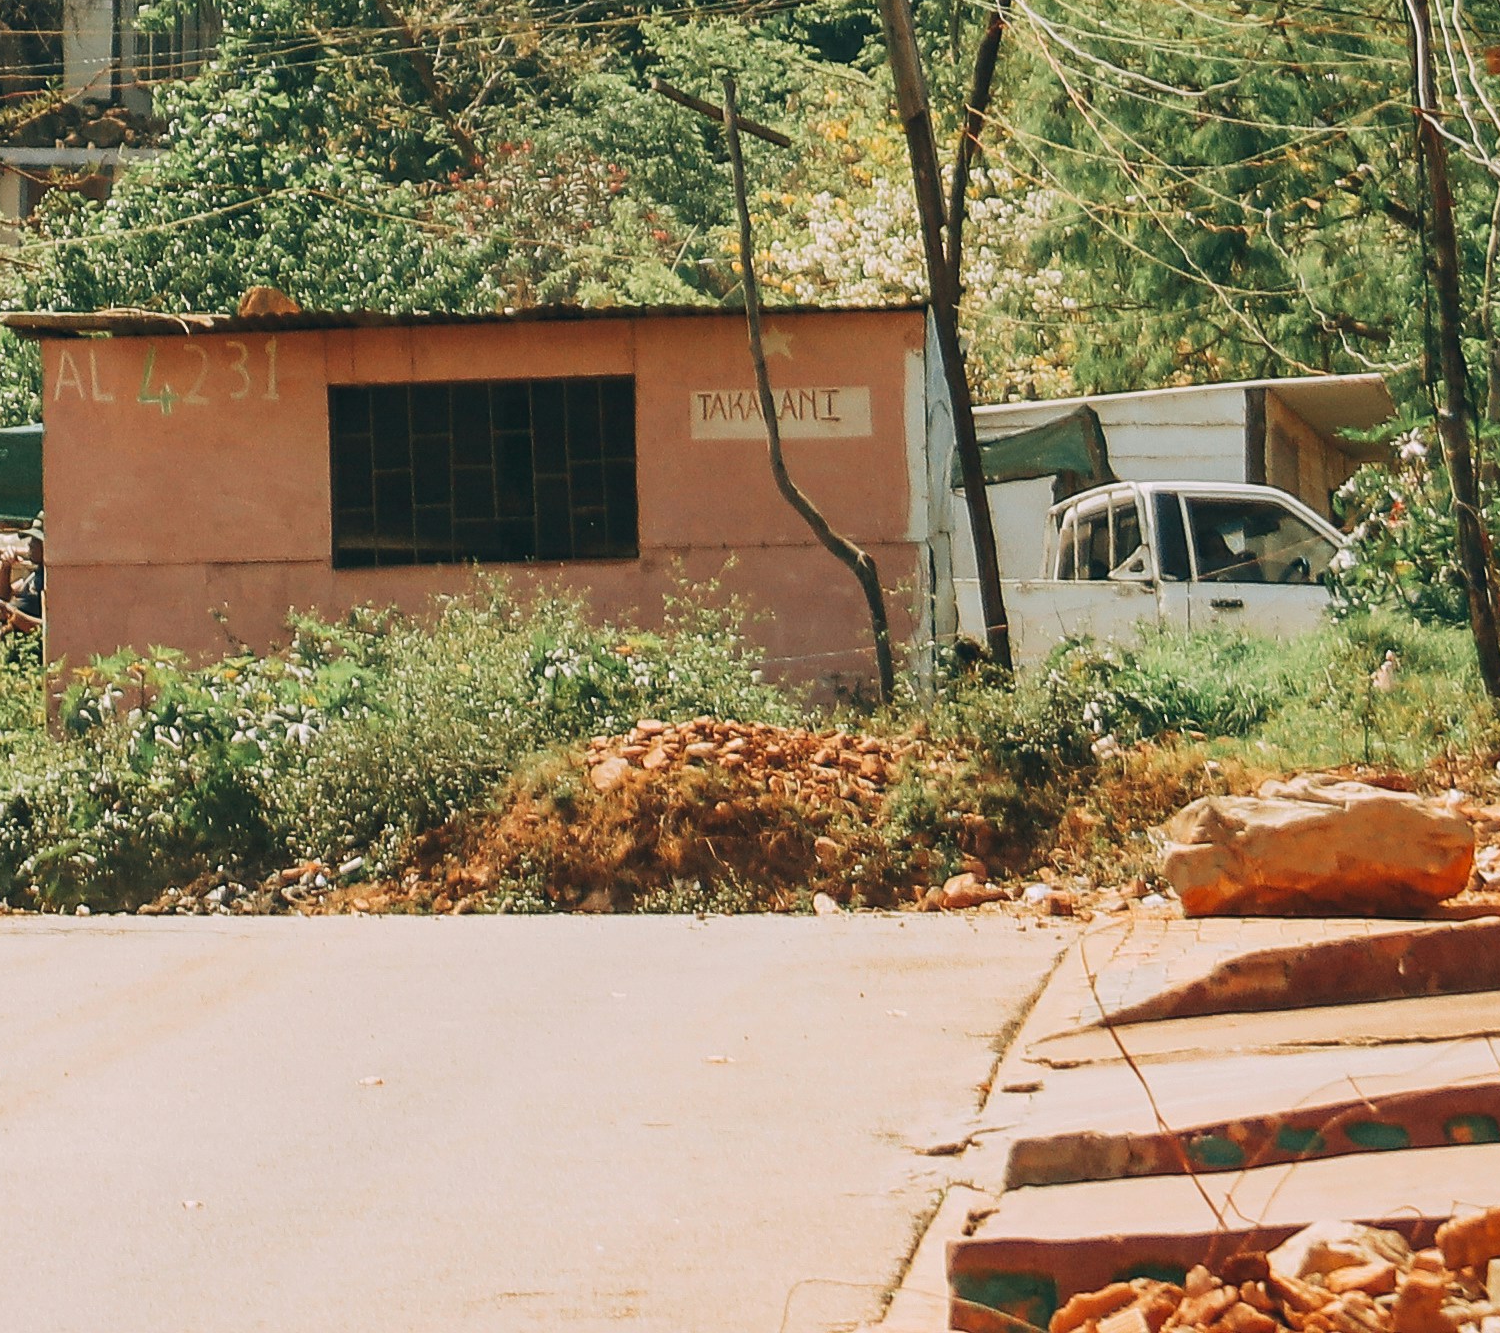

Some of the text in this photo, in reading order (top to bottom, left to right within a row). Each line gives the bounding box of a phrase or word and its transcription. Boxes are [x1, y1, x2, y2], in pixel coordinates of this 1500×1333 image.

[53, 336, 281, 416] AL 4231
[697, 389, 841, 422] TAKAANI
